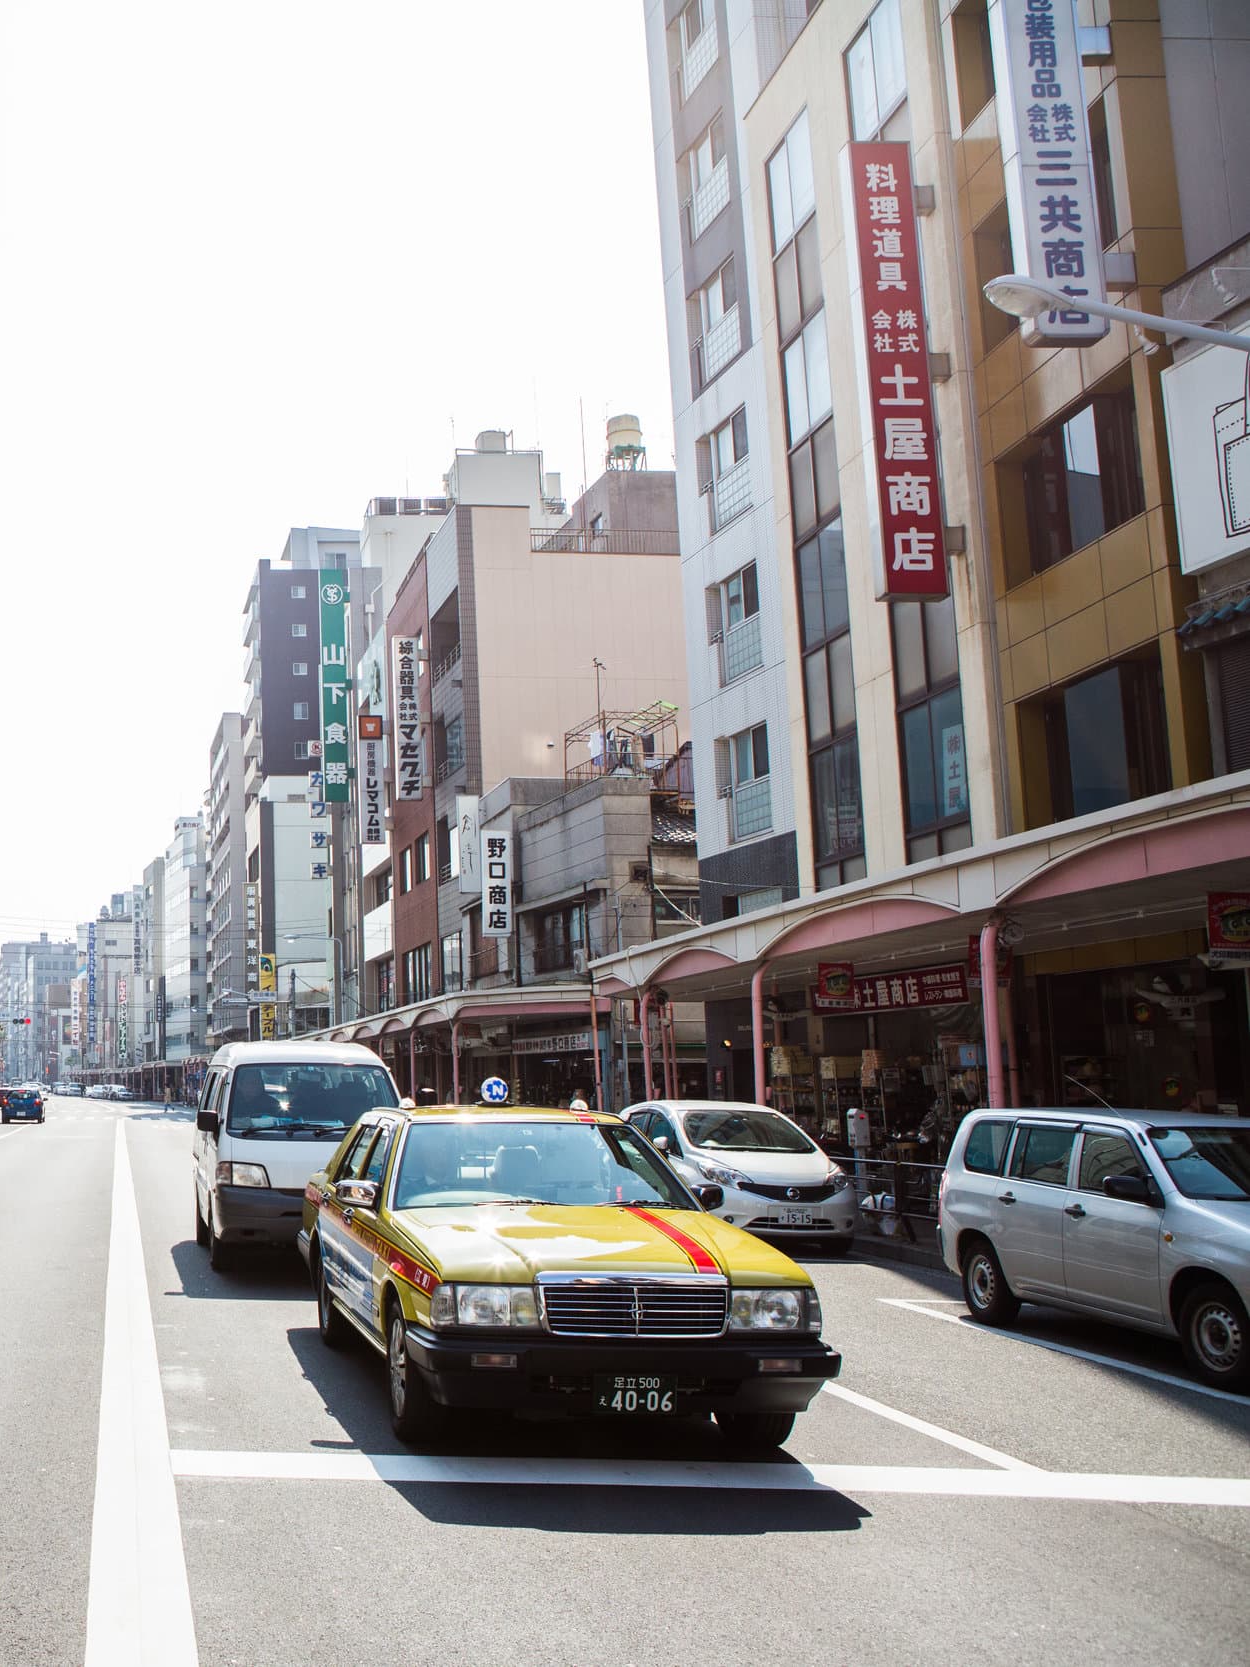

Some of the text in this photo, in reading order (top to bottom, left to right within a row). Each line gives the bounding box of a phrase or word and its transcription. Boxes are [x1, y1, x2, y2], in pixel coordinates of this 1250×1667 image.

[866, 163, 908, 292] 料理道具
[878, 363, 936, 572] 土屋商店
[323, 643, 350, 786] 山下食器
[311, 771, 327, 878] カワサキ
[366, 777, 380, 827] レマコム
[487, 838, 507, 929] 野口商店
[492, 1084, 504, 1096] N
[611, 1390, 674, 1412] 40-06
[613, 1376, 660, 1389] 足立 500
